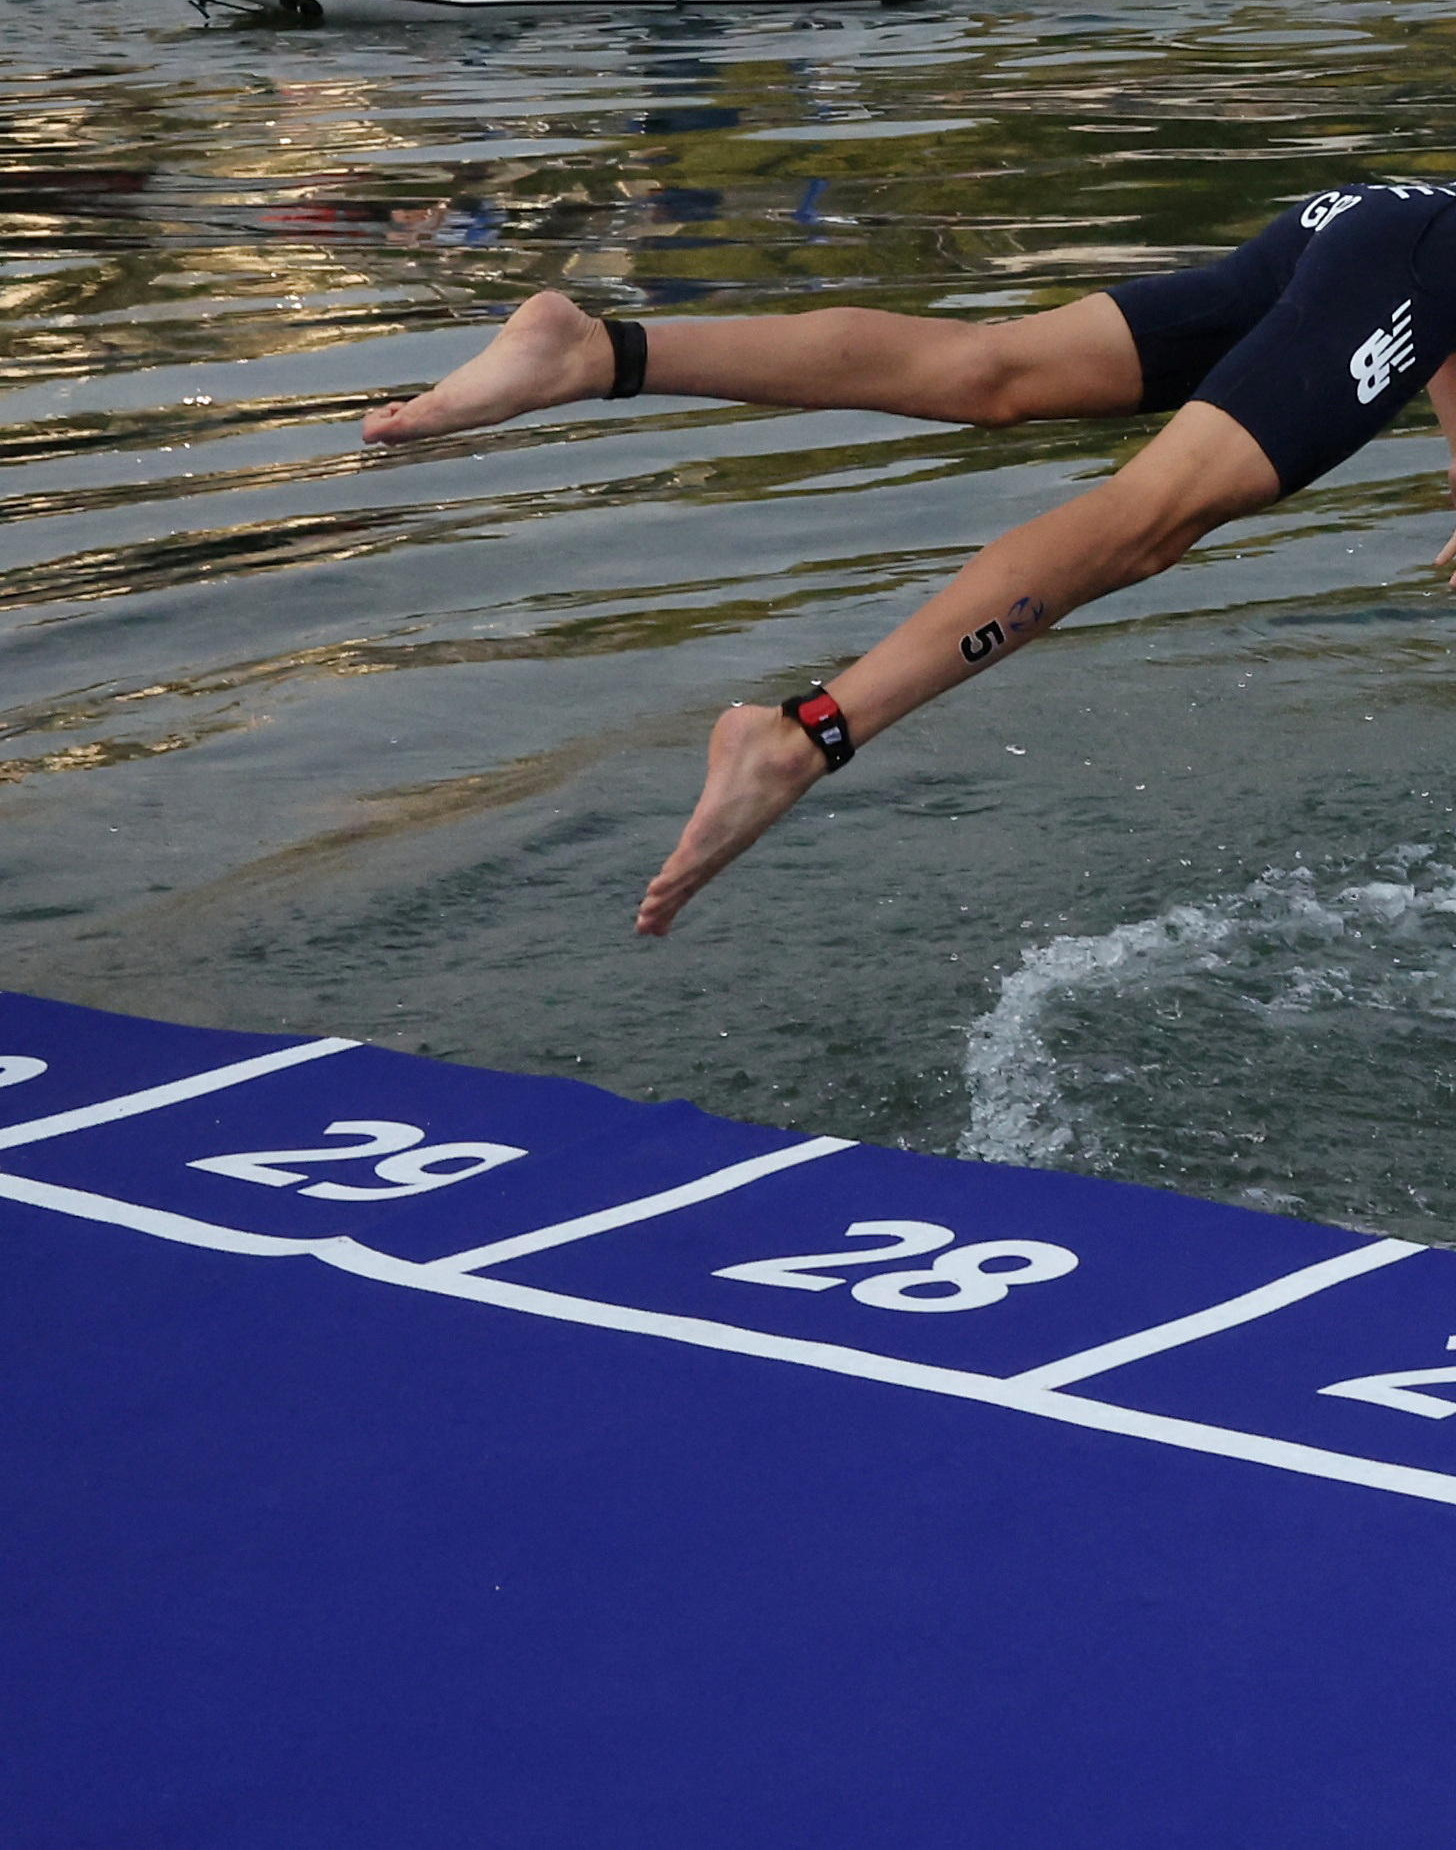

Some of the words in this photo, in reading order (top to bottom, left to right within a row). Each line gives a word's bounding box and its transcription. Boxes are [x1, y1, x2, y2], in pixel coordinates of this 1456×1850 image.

[960, 617, 1006, 666] 5
[186, 1120, 529, 1201] 29
[711, 1220, 1079, 1313] 28
